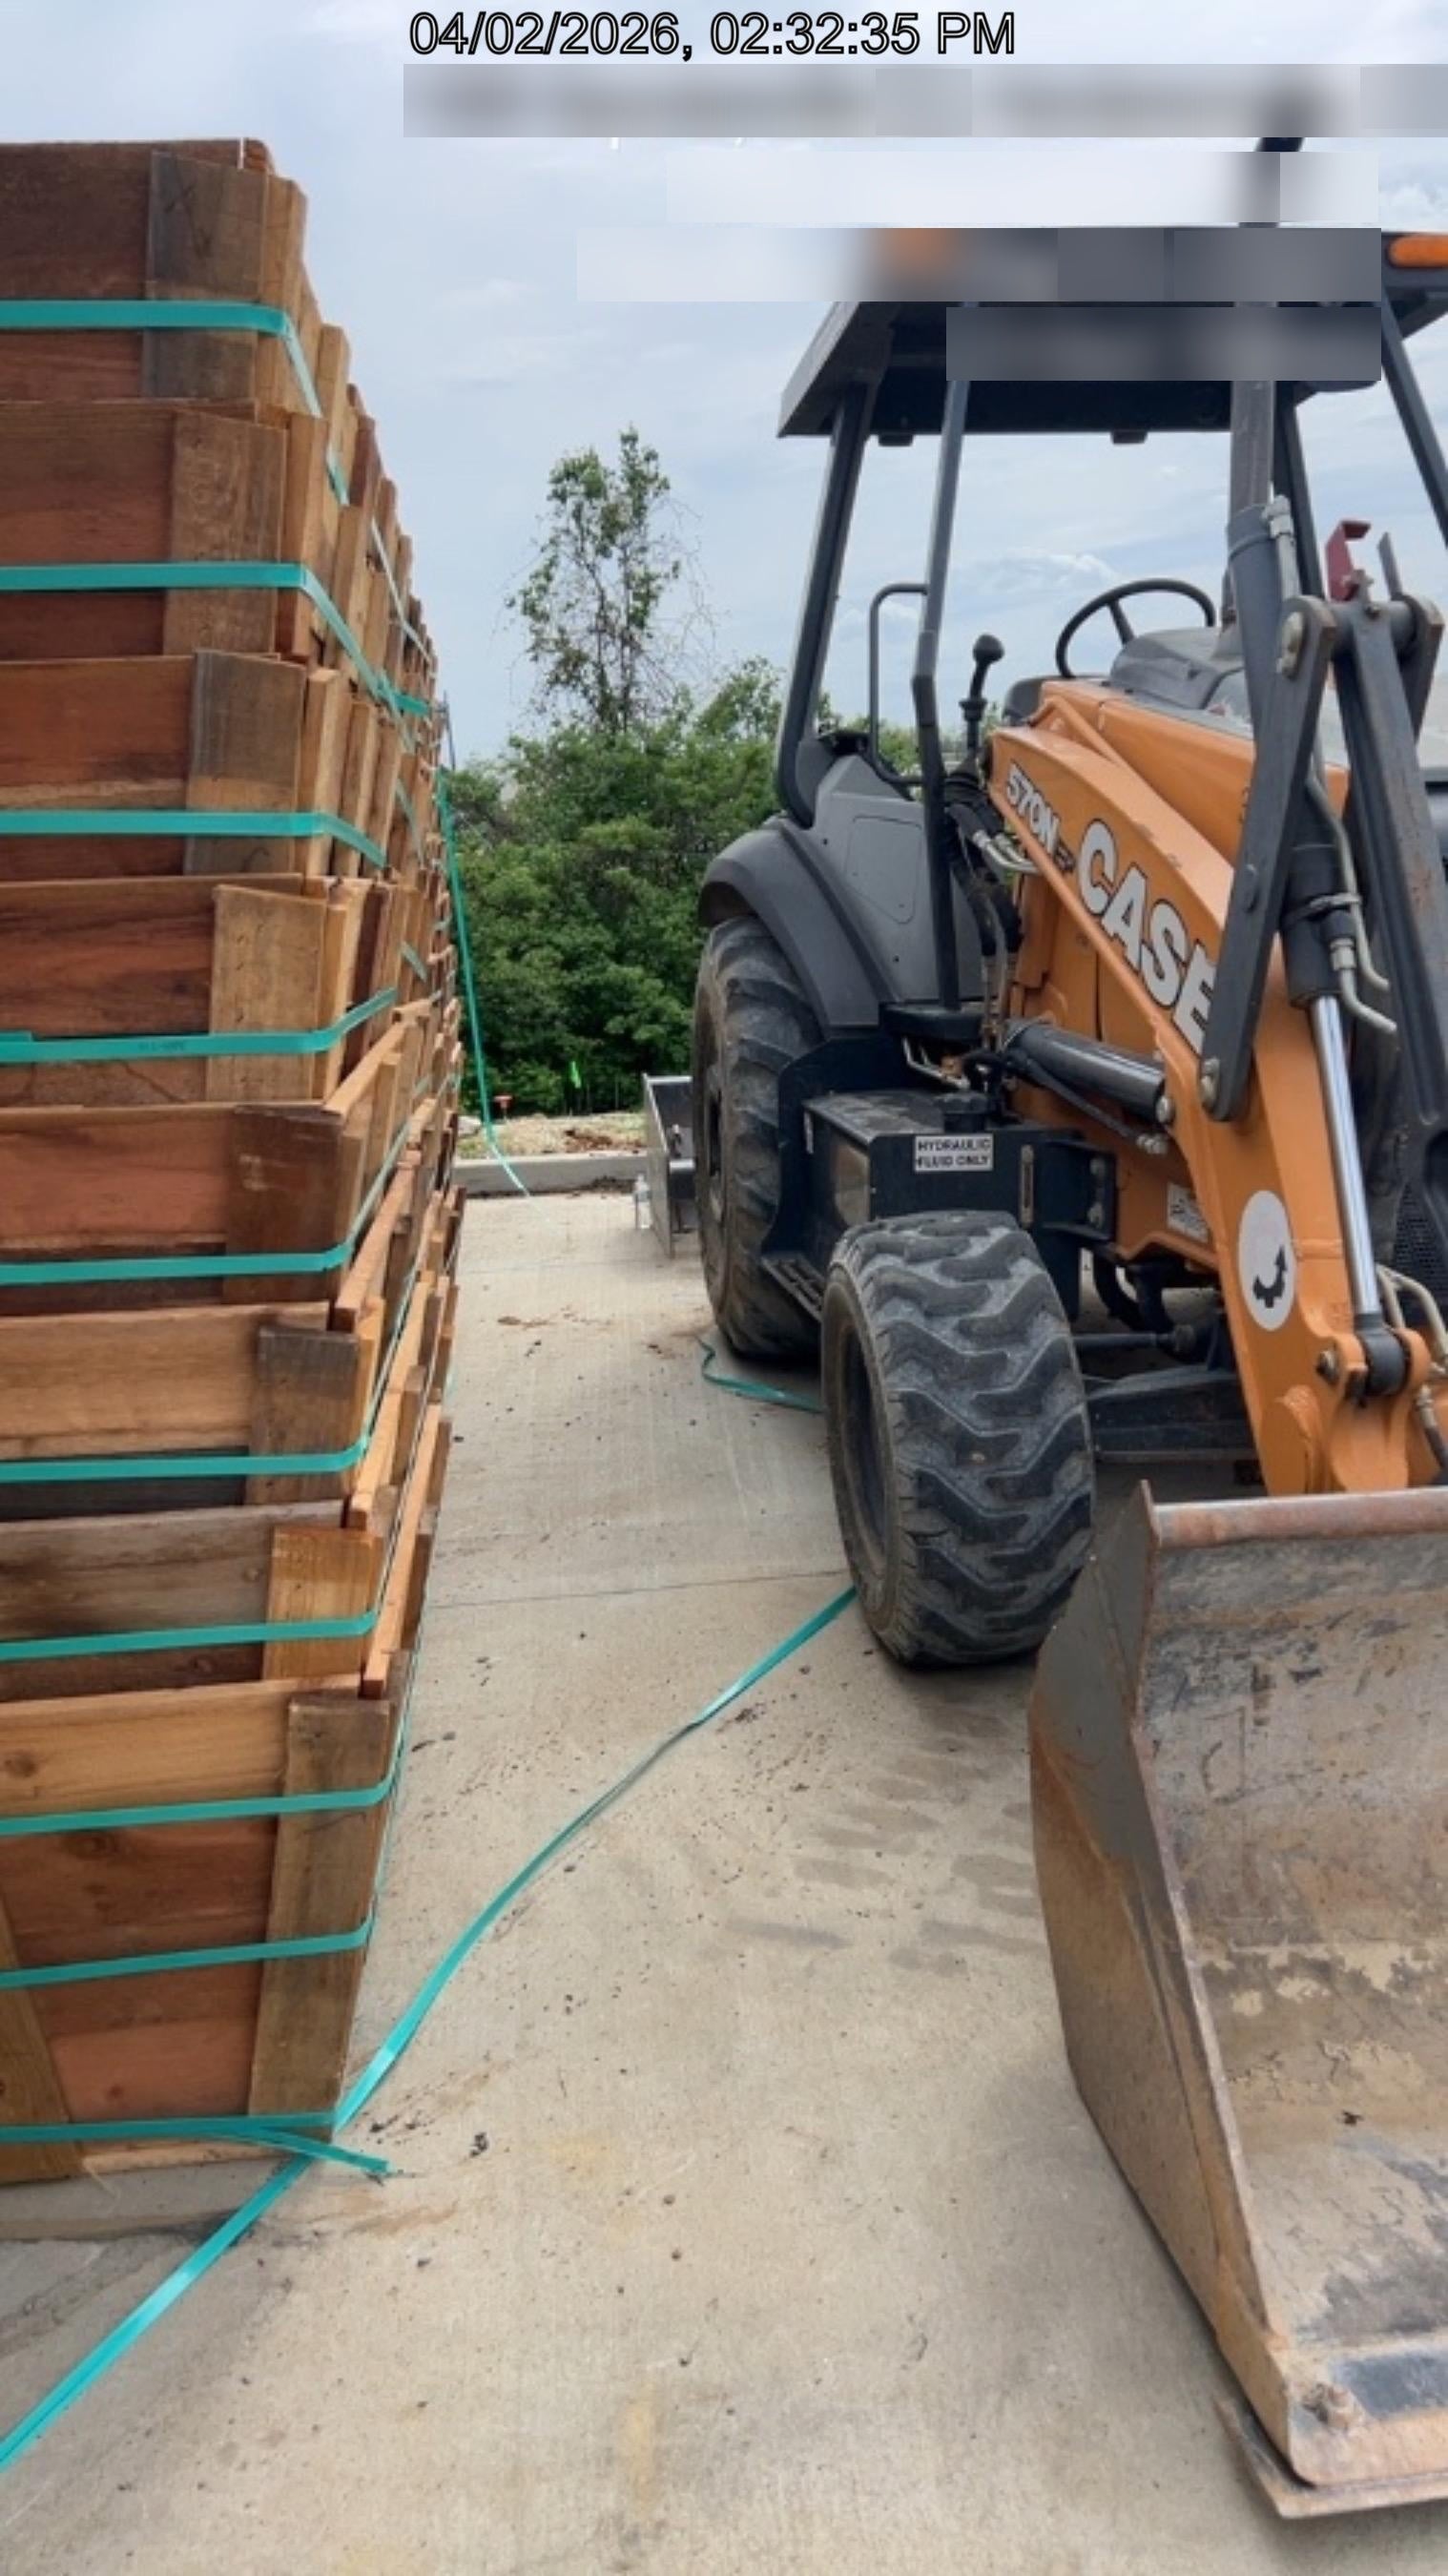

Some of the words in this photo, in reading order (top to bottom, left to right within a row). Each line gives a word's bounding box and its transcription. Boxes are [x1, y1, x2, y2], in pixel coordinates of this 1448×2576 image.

[1005, 761, 1060, 855] 570N
[1077, 819, 1217, 1055] CASE
[917, 1155, 953, 1168] FLUID
[957, 1154, 988, 1166] ONLY
[918, 1136, 991, 1151] HYDRAULIC
